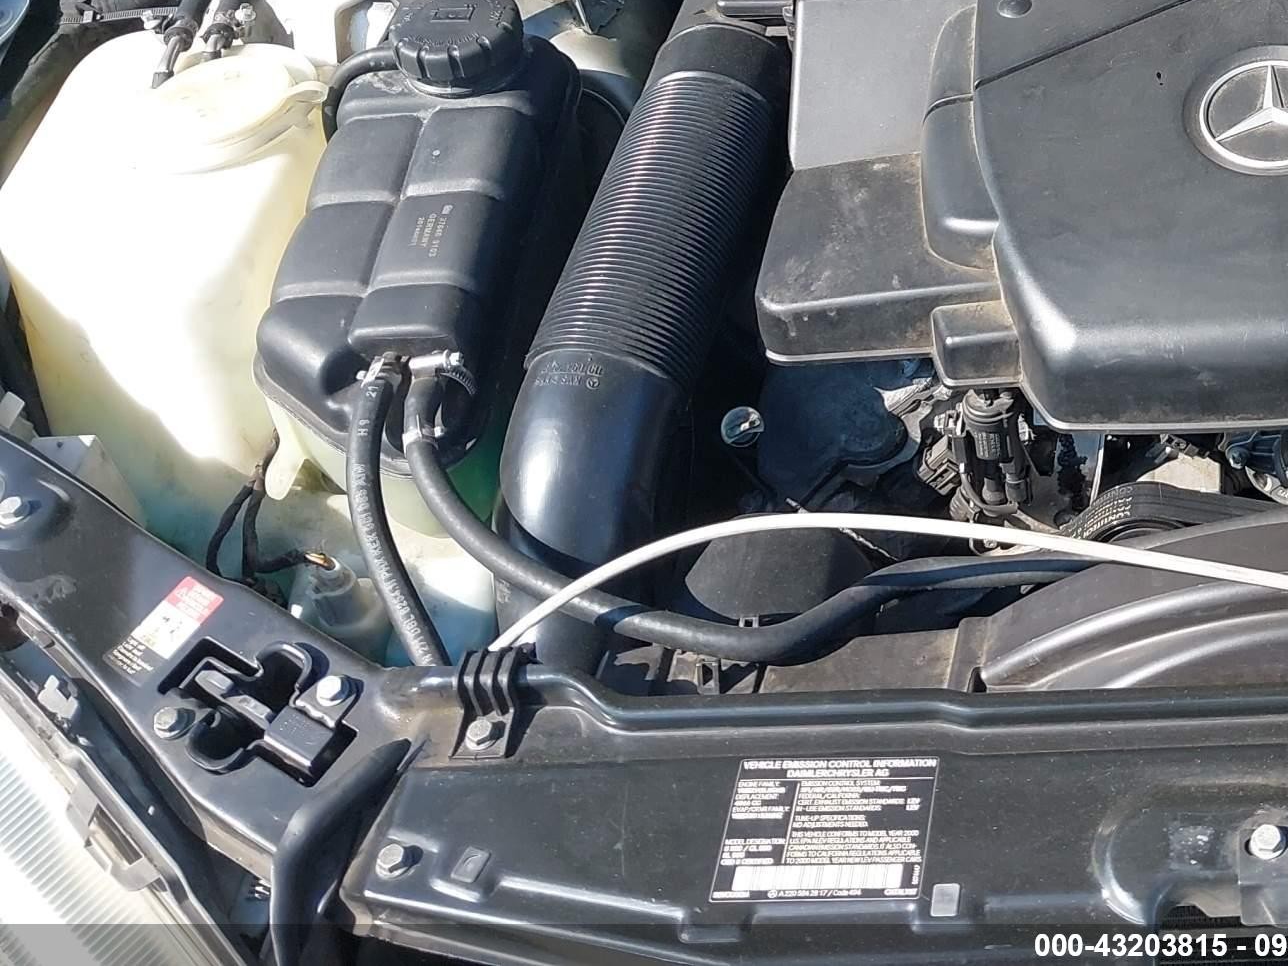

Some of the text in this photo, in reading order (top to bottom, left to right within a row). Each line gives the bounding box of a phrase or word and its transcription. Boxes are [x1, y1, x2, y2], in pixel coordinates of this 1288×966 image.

[744, 759, 937, 770] VEHICLE EMISSION CONTROL INFORMATION
